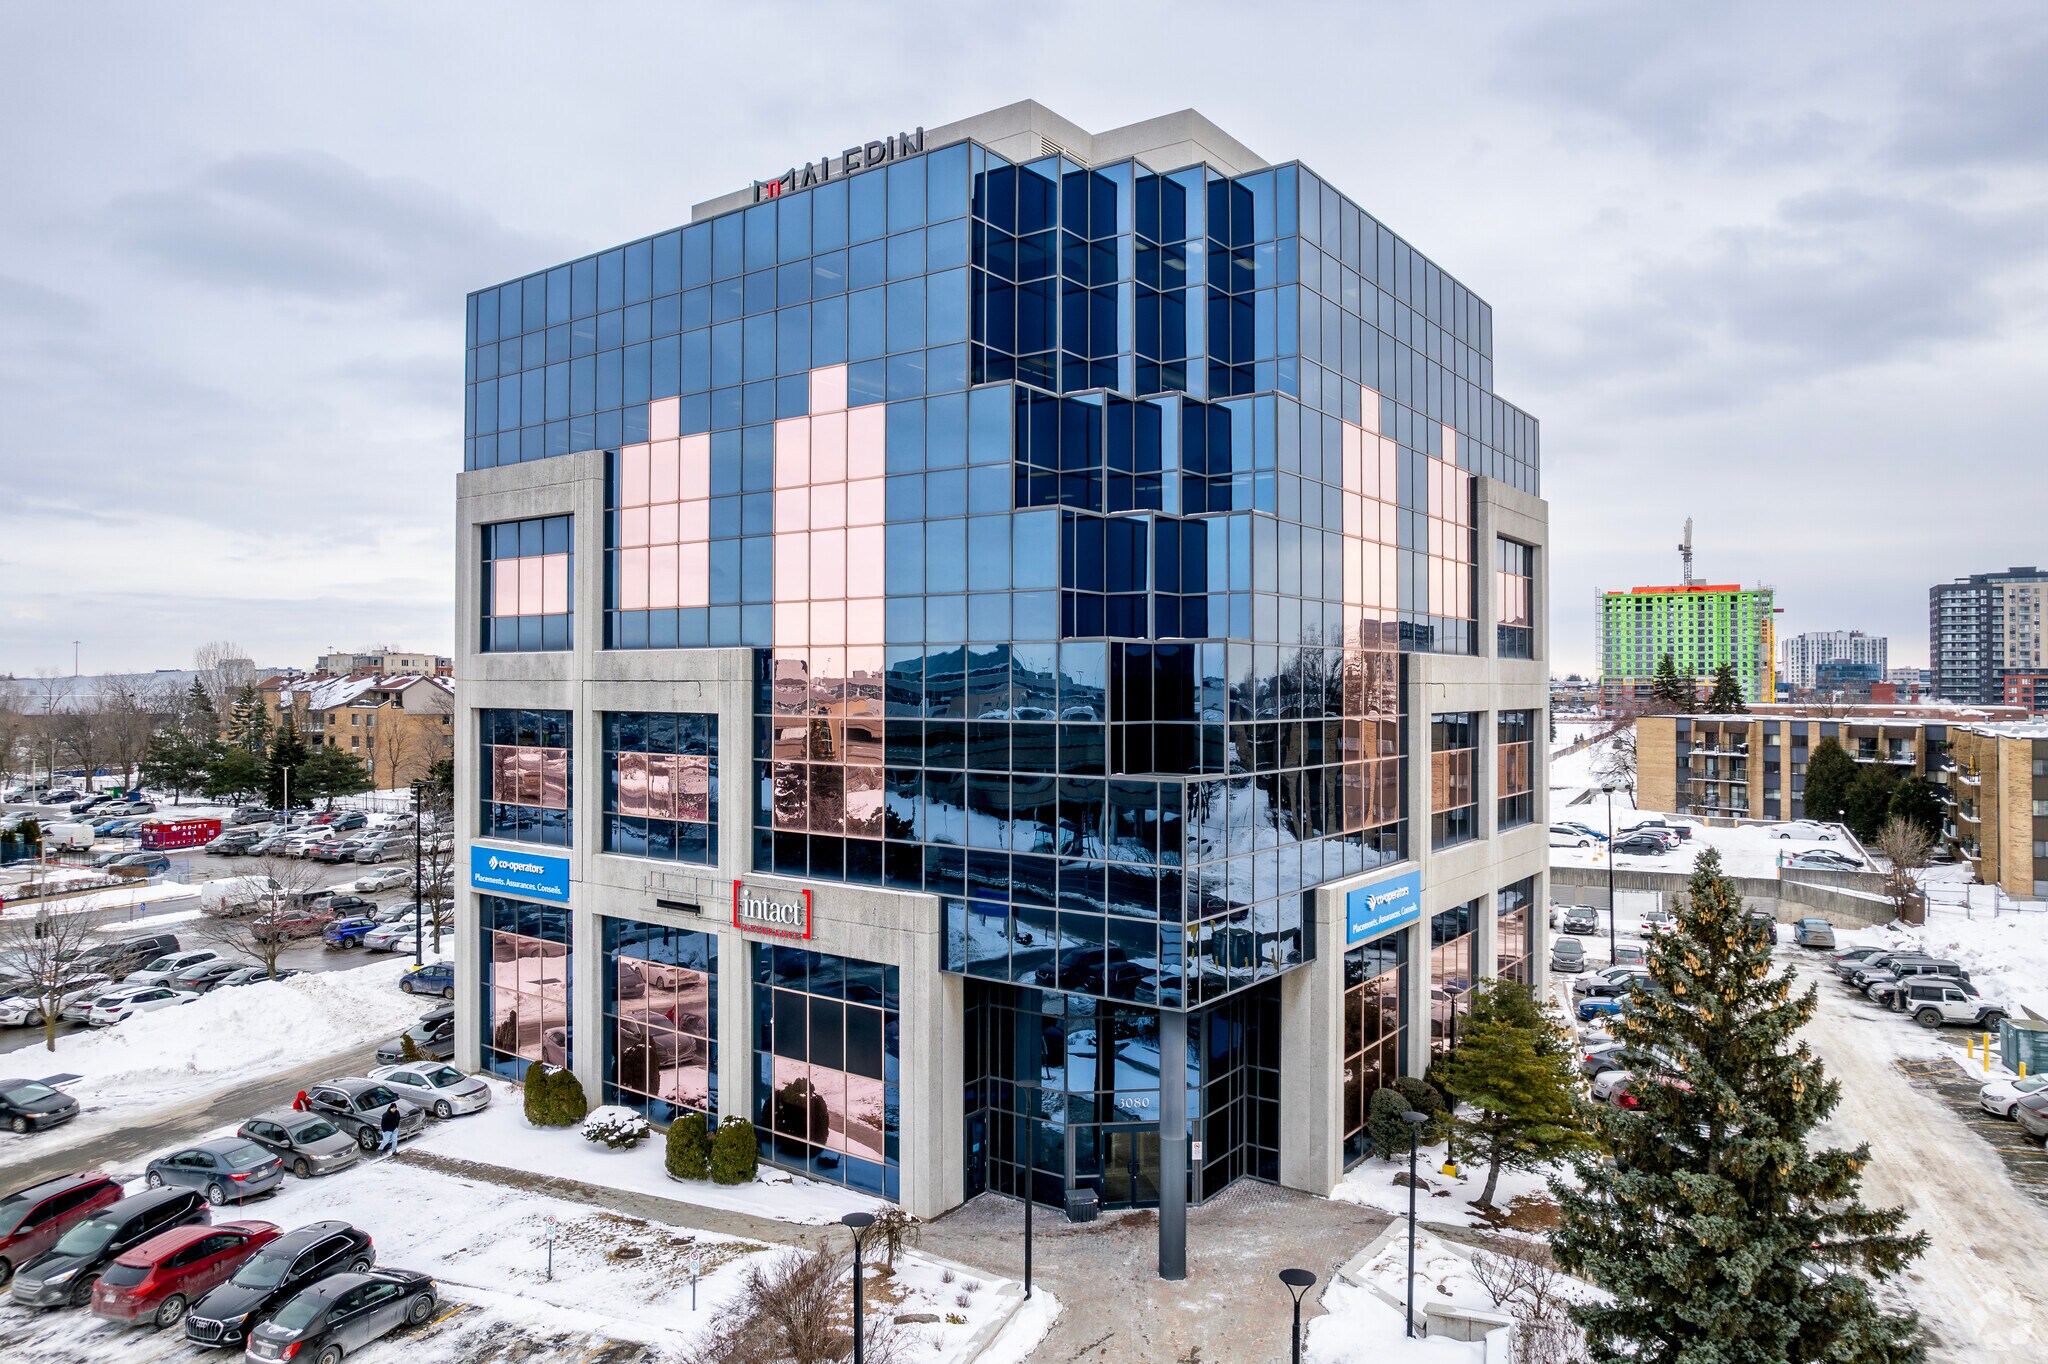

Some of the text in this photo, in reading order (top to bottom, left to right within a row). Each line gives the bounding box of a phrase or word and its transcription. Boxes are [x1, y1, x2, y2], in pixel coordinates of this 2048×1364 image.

[499, 860, 544, 874] co-operators
[475, 873, 562, 894] Placements. Assurances. Conseils.
[743, 889, 802, 925] intact
[1119, 1097, 1150, 1109] 3080
